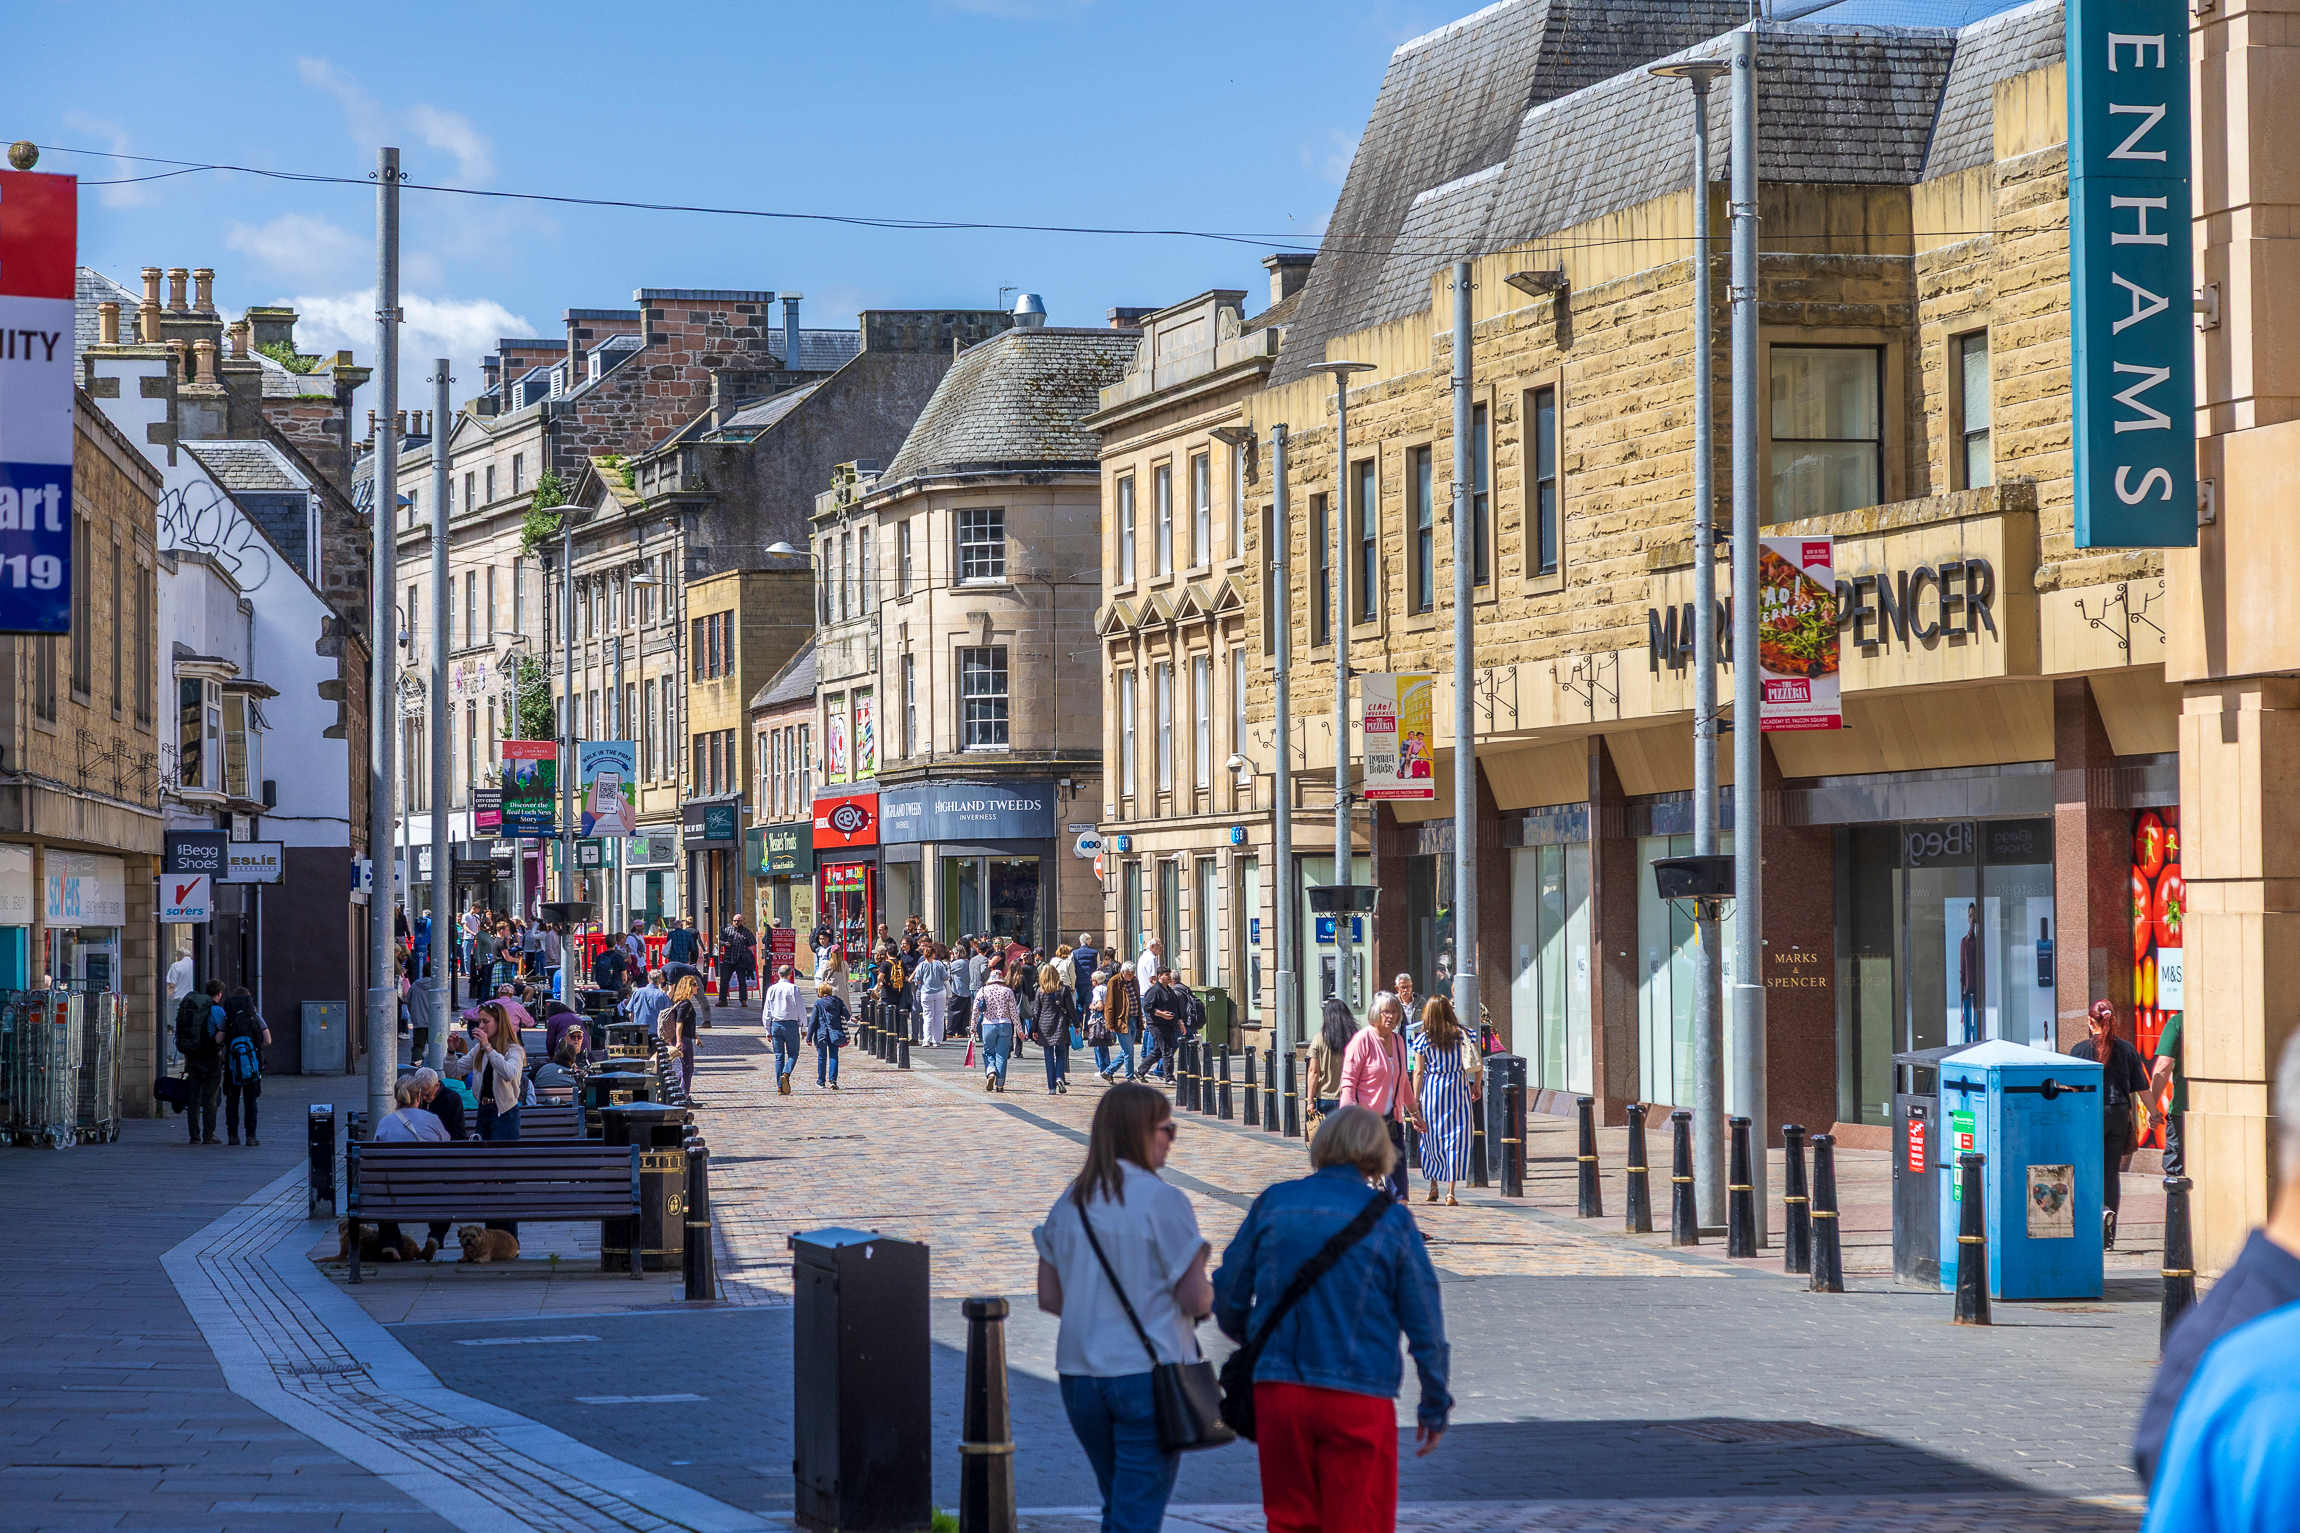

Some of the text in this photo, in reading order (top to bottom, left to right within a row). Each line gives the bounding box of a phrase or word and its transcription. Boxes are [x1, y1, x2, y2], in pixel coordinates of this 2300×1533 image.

[2107, 31, 2173, 507] ENHAMS
[1768, 687, 1808, 699] PIZZERIA
[935, 799, 1041, 814] HIGHLAND TWEEDS
[959, 813, 998, 821] INVERNESS
[183, 844, 218, 858] Begg
[178, 857, 218, 869] Shoes
[166, 906, 204, 916] savers
[1775, 953, 1817, 963] MARKS
[2161, 965, 2183, 983] M&S
[1767, 977, 1827, 988] SPENCER
